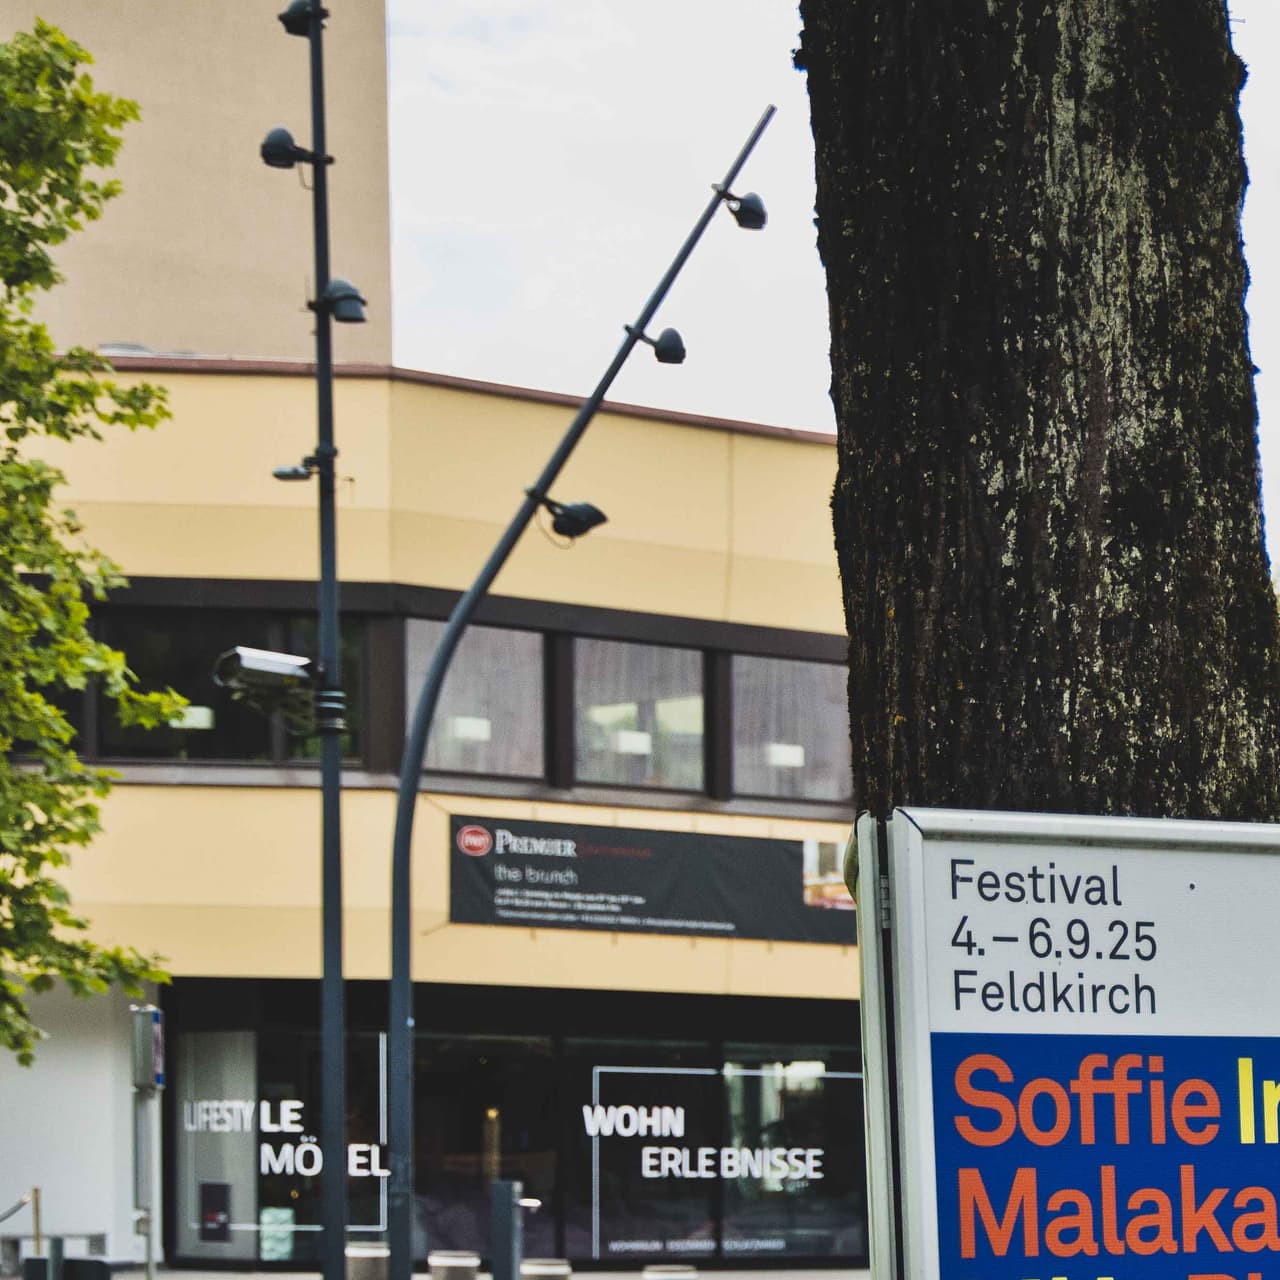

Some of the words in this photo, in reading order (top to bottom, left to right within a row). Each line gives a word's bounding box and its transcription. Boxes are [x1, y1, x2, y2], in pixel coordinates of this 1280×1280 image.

[494, 863, 523, 882] the
[525, 864, 579, 885] brunch
[951, 859, 1122, 906] Festival
[954, 969, 1156, 1014] Feldkirch
[582, 1104, 685, 1138] WOHN
[954, 1053, 1221, 1147] Soffie
[260, 1134, 392, 1177] MÖEL
